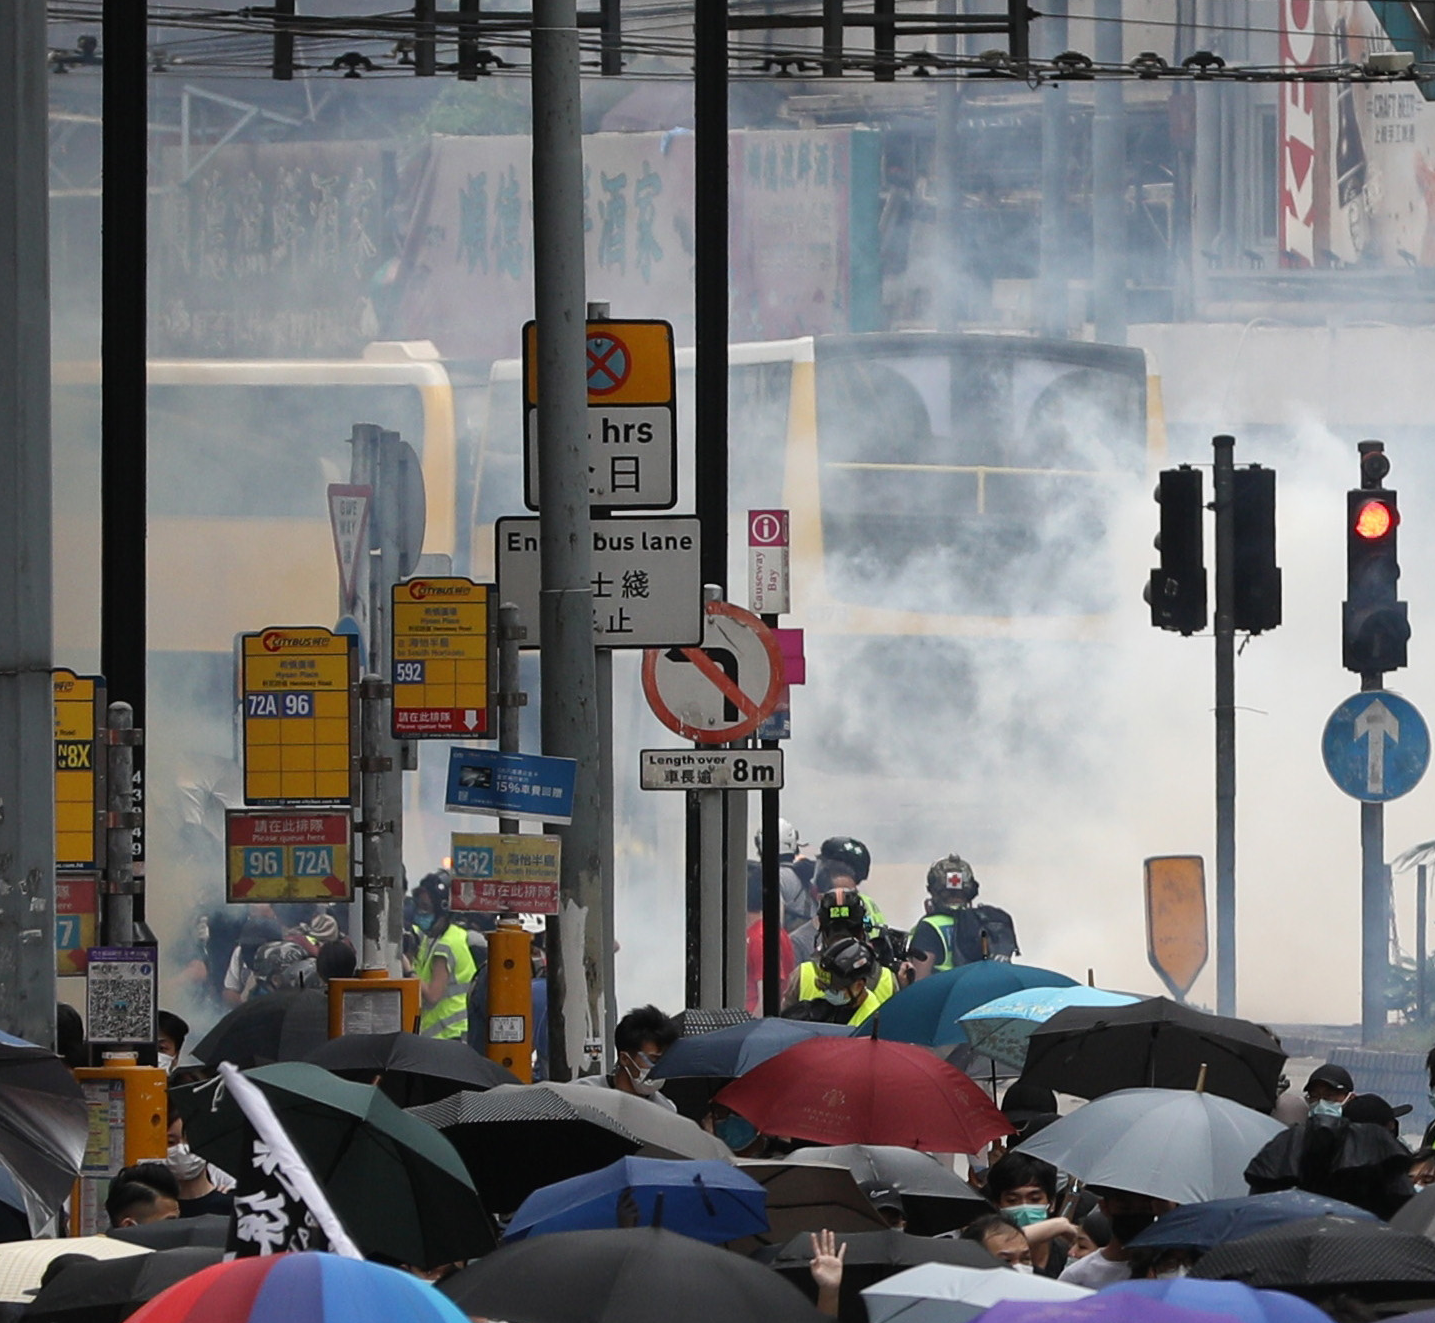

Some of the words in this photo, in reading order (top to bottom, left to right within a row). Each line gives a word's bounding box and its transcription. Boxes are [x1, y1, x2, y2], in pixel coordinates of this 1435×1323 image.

[602, 418, 653, 443] hrs
[507, 532, 538, 551] En
[593, 532, 635, 551] bus
[642, 532, 692, 551] lane
[753, 551, 764, 612] Causeway
[767, 569, 777, 593] Bay
[418, 586, 453, 595] CITYBUS
[273, 636, 312, 647] CITYBUS
[397, 663, 421, 681] 592
[248, 695, 278, 715] 72A
[285, 694, 309, 715] 96
[649, 754, 695, 767] Length
[697, 756, 727, 765] over
[664, 768, 712, 785] 車長逾
[732, 758, 775, 783] 8m
[496, 782, 563, 798] 15%車費回贈
[254, 819, 324, 834] 請在此排隊
[252, 833, 277, 842] Please
[279, 835, 305, 844] queue
[307, 833, 326, 841] here
[249, 852, 278, 875] 96
[295, 851, 331, 875] 72A
[458, 851, 489, 874] 592
[483, 883, 551, 898] 請在此排隊
